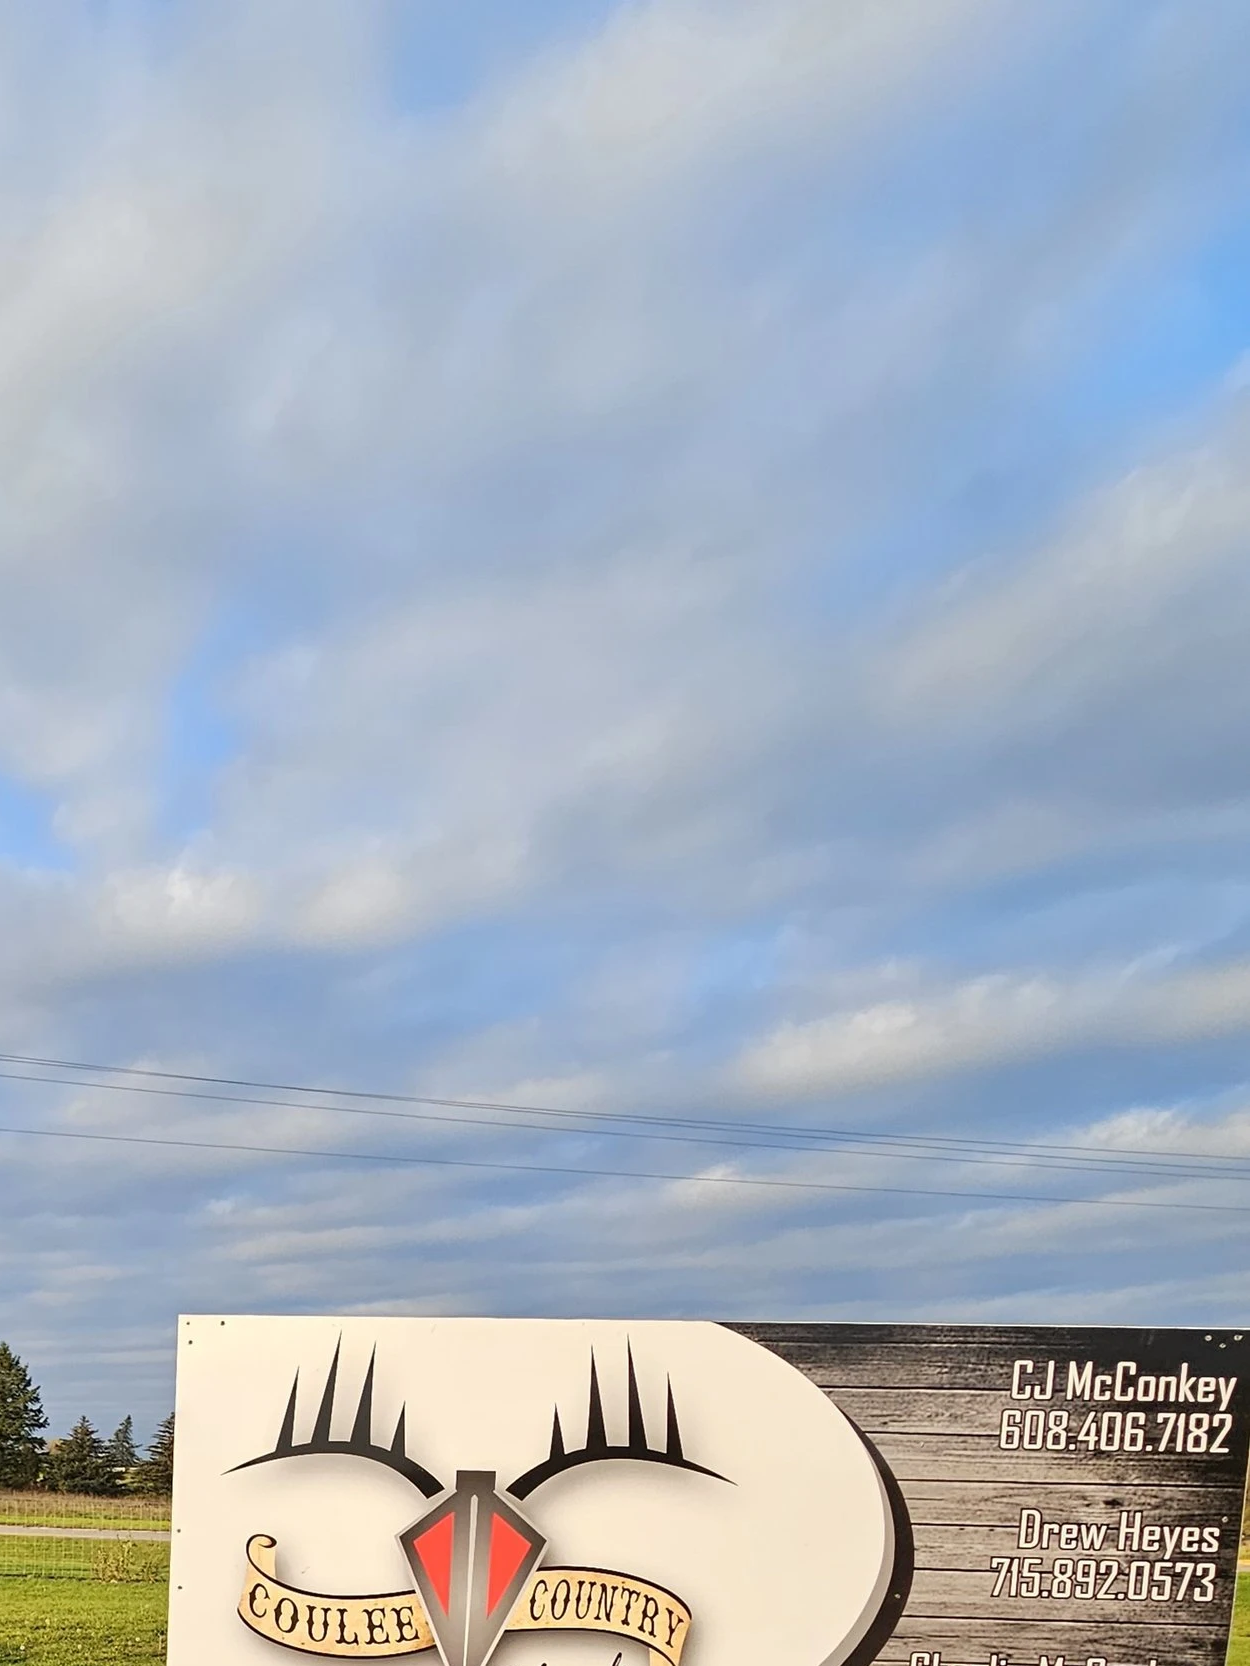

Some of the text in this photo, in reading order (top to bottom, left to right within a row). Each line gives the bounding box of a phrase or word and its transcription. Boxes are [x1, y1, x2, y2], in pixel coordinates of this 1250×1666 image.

[1011, 1359, 1237, 1411] CJ McConkey
[999, 1409, 1233, 1454] 608.406.7182
[1018, 1508, 1220, 1560] Drew Heyes
[990, 1557, 1216, 1602] 715.892.0573
[249, 1579, 686, 1649] COULEE COUNTRY
